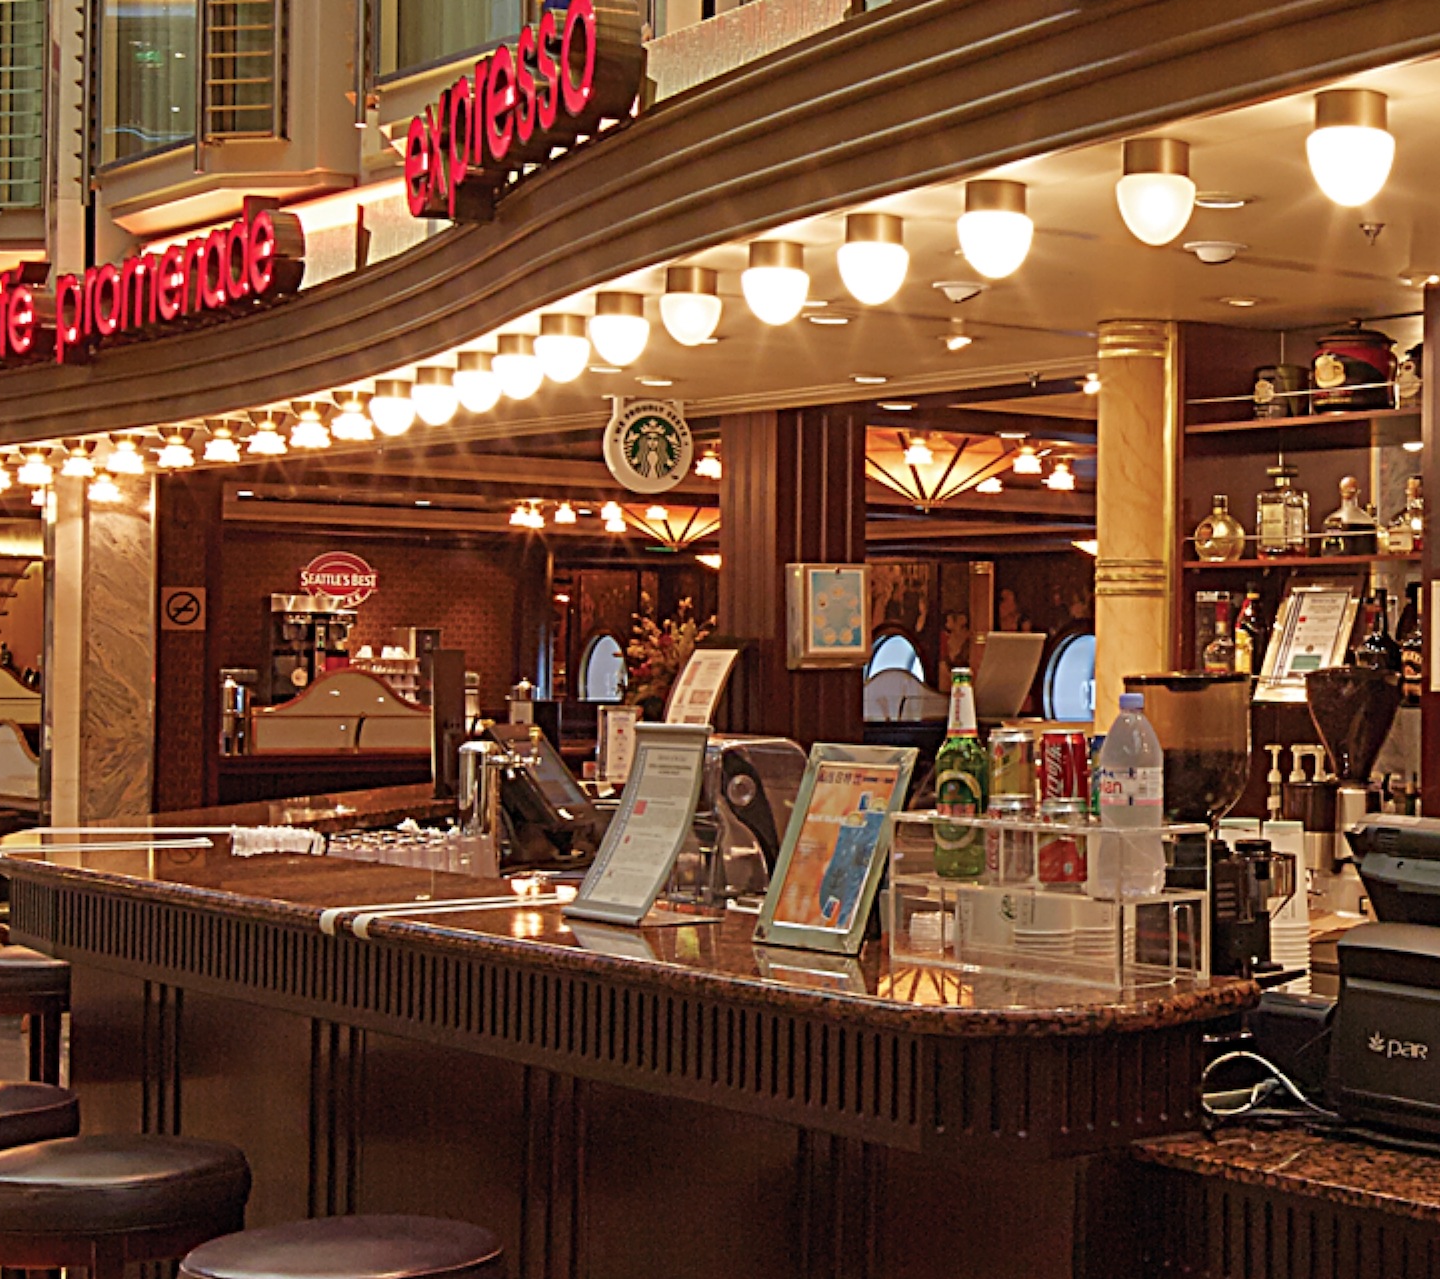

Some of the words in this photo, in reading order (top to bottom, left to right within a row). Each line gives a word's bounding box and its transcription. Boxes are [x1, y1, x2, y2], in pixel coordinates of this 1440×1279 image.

[56, 202, 282, 363] promenade
[300, 570, 350, 587] SEATTLE'S
[350, 573, 377, 588] BEST
